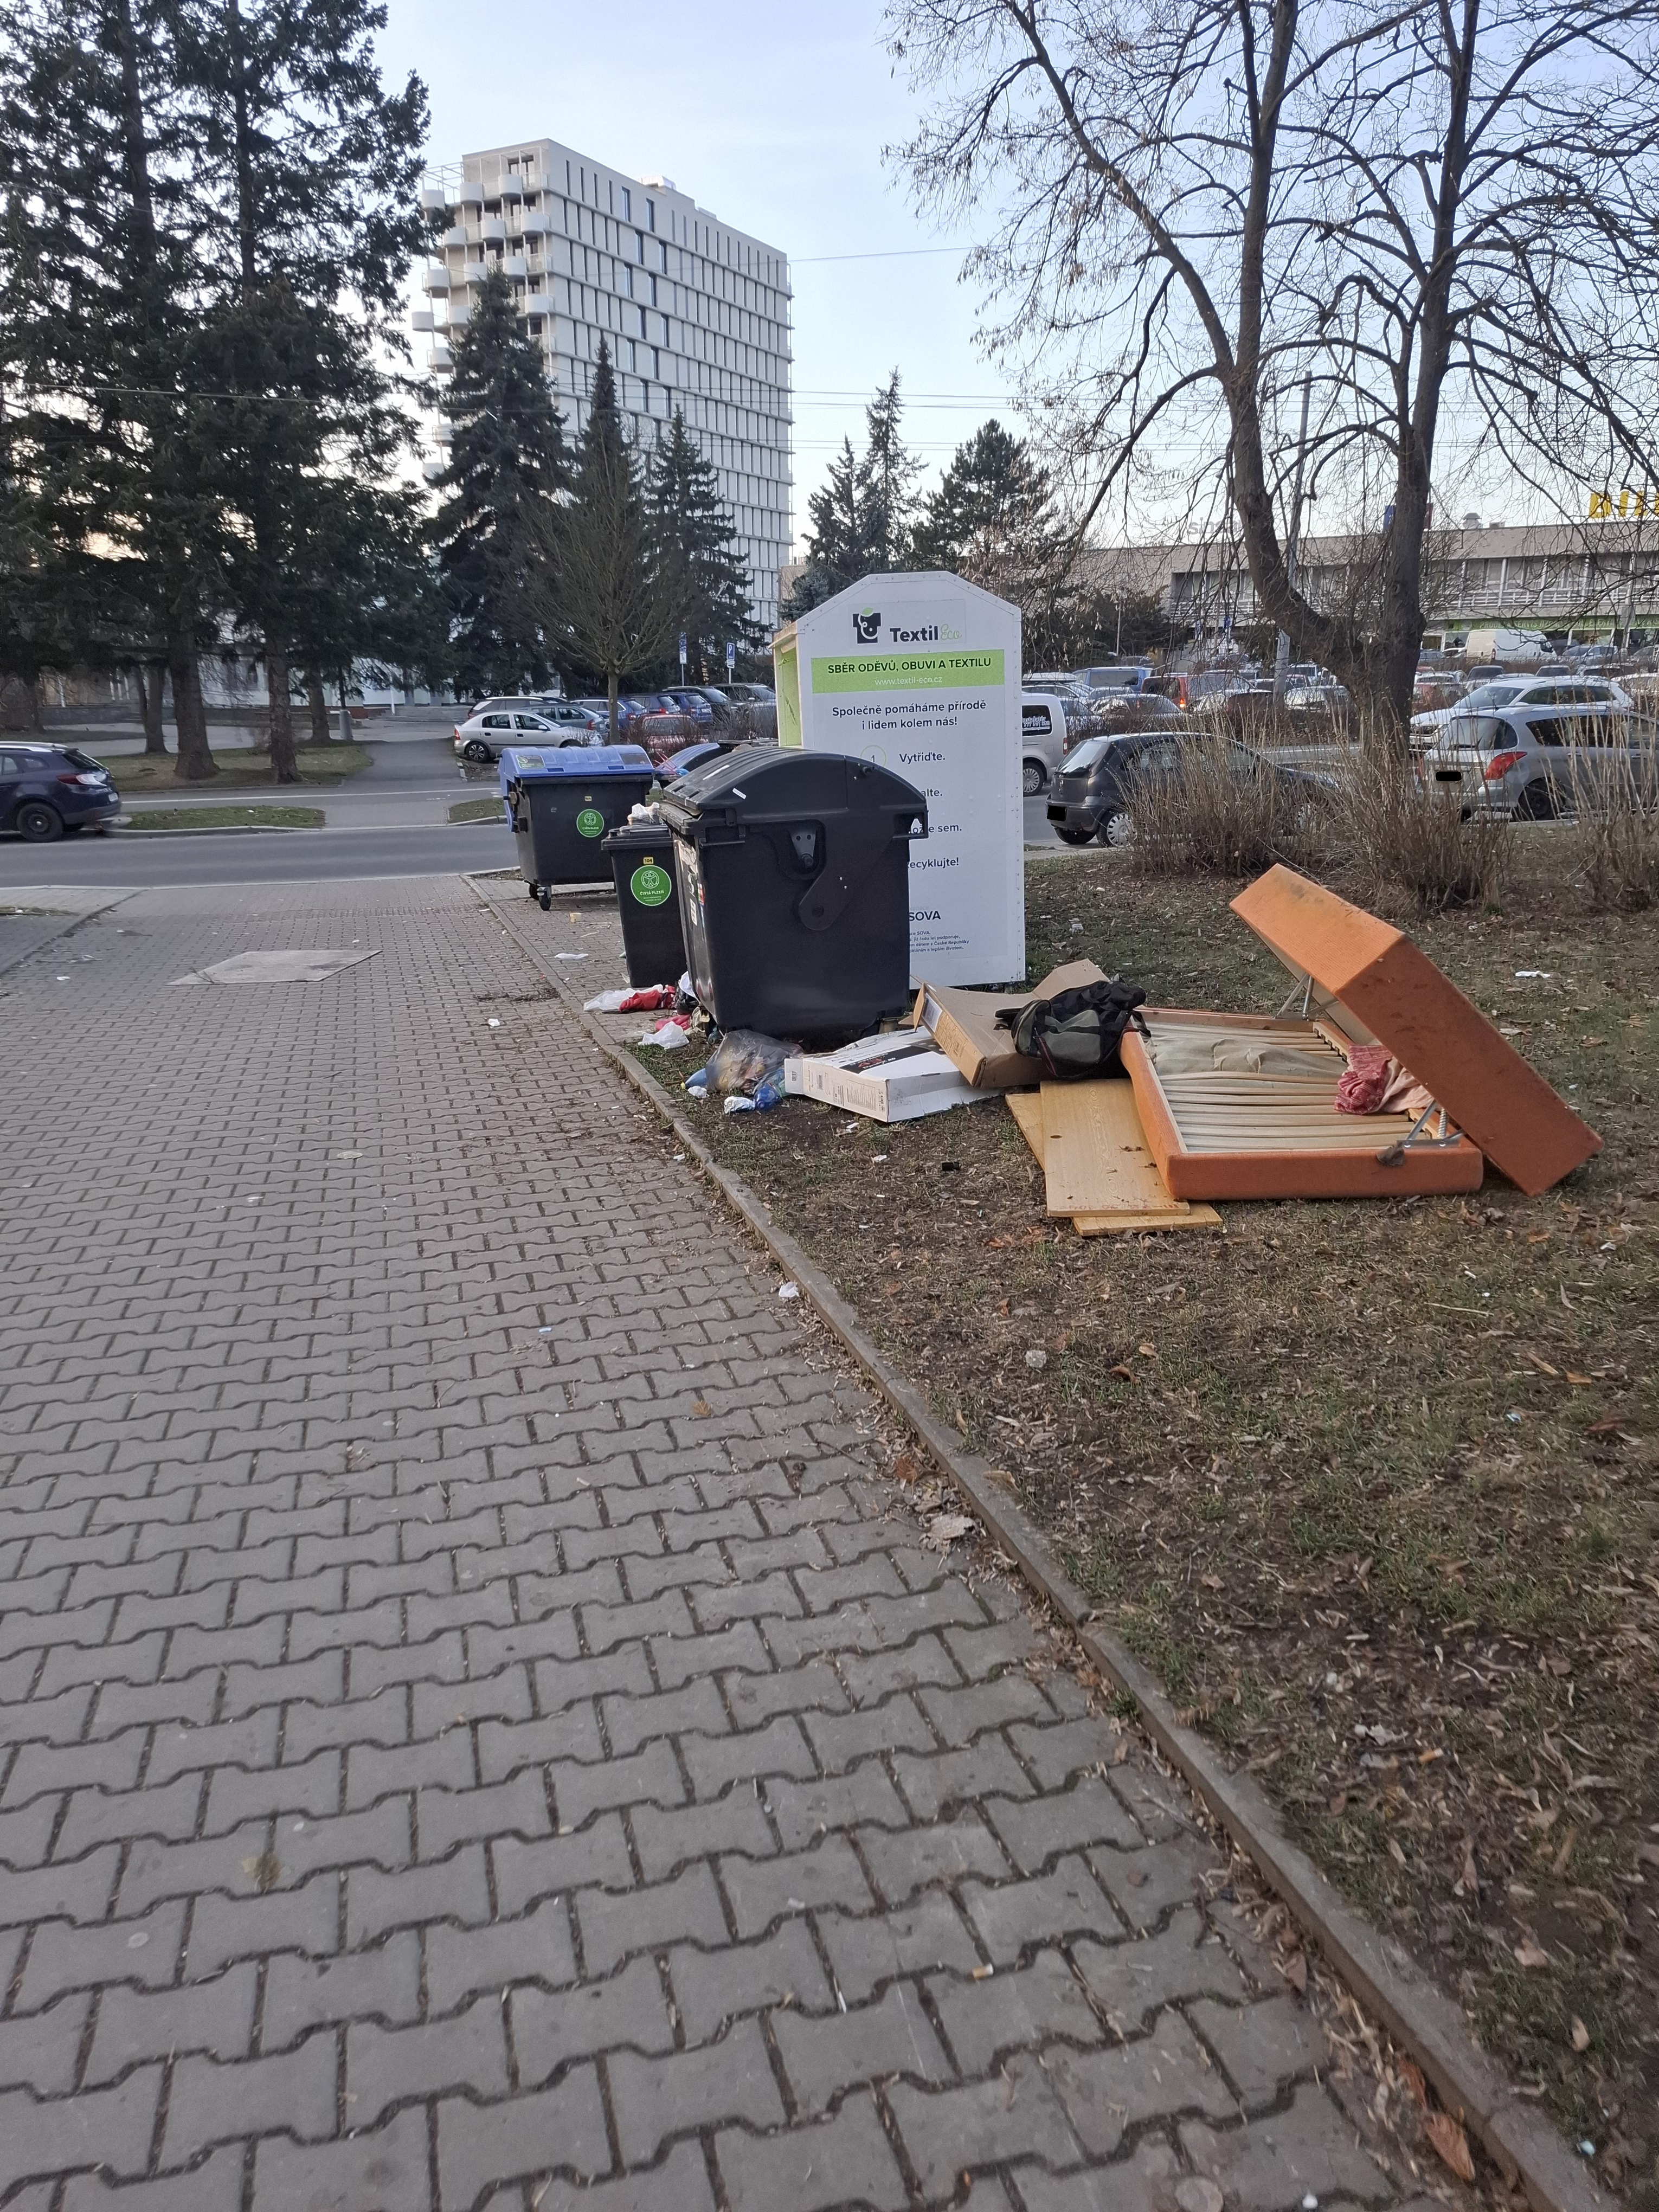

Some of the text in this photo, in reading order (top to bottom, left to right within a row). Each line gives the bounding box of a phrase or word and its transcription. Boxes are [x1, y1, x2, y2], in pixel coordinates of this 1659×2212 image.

[889, 625, 938, 642] Textil
[828, 658, 991, 674] SBĚR ODĚVŮ, OBUVI A TEXTILU
[874, 676, 943, 686] www.textil-eco.cz
[832, 699, 987, 718] Společně pomáháme přírodě
[861, 716, 958, 730] i lidem kolem nás!
[899, 752, 946, 764] Vytřiďte.
[921, 788, 943, 797] alte.
[937, 824, 962, 833] sem.
[909, 910, 941, 922] SOVA
